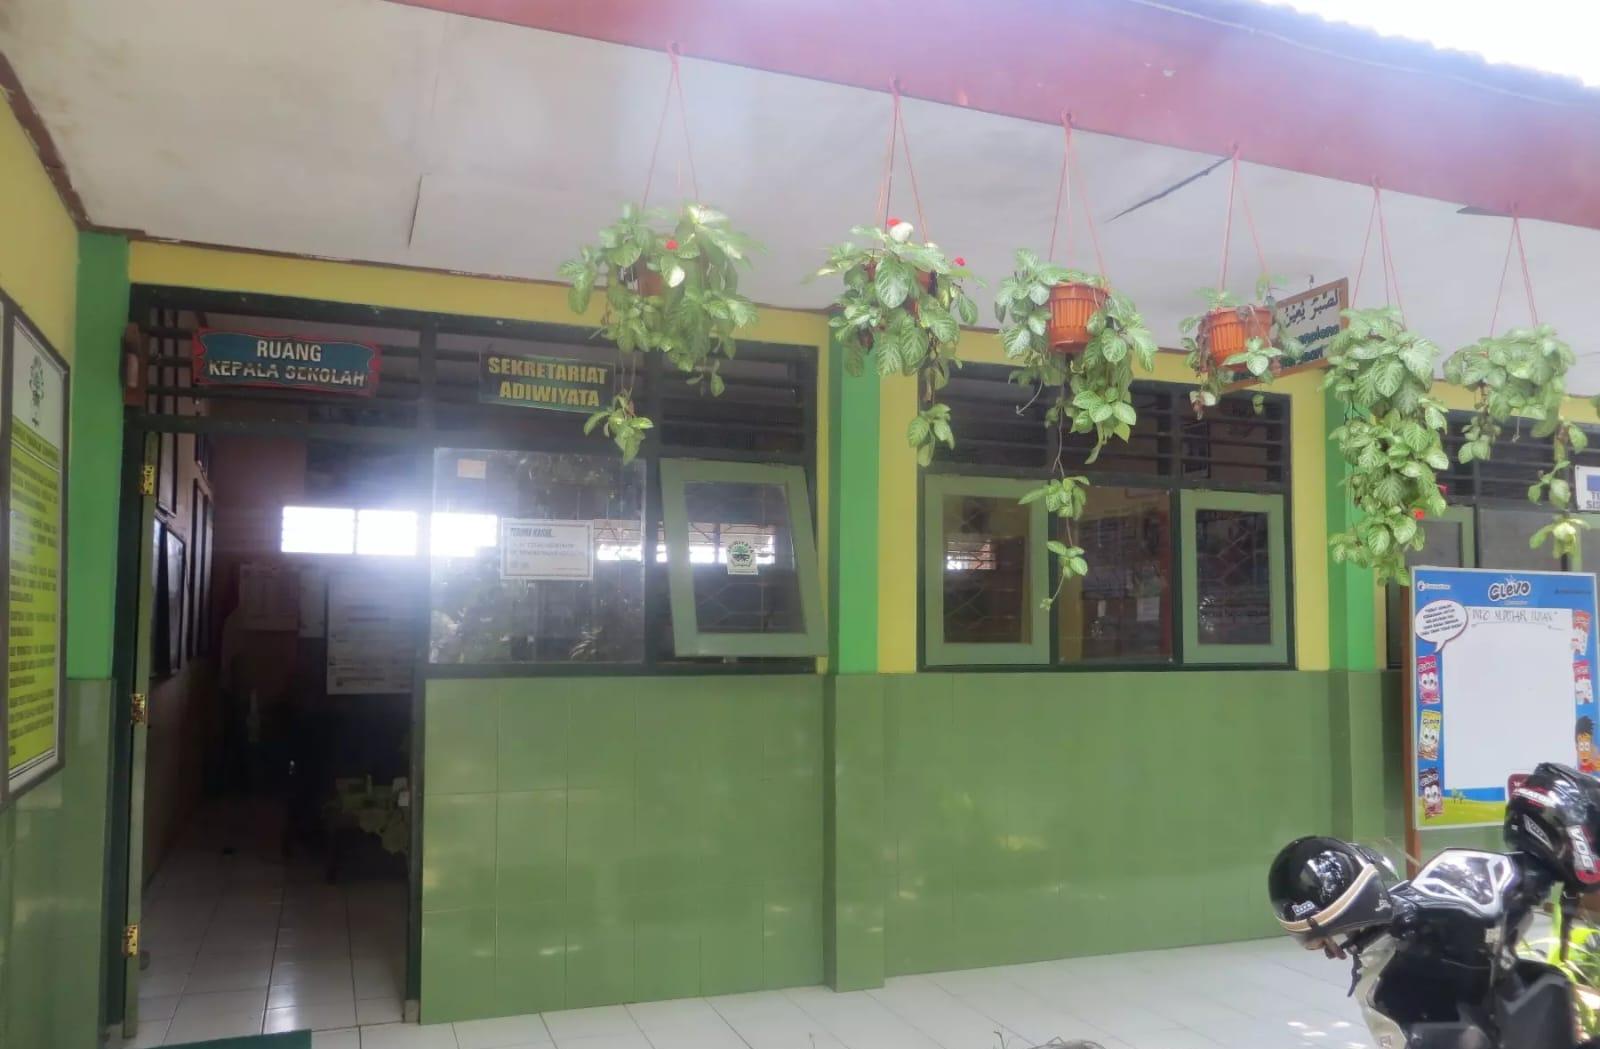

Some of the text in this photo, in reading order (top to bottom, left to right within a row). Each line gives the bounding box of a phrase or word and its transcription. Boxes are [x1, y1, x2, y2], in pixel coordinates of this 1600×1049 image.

[256, 339, 322, 362] RUANG
[208, 359, 365, 387] KEPALA SEKOLAH
[487, 356, 608, 385] SEKRETARIAT
[499, 381, 600, 407] ADIWIYATA
